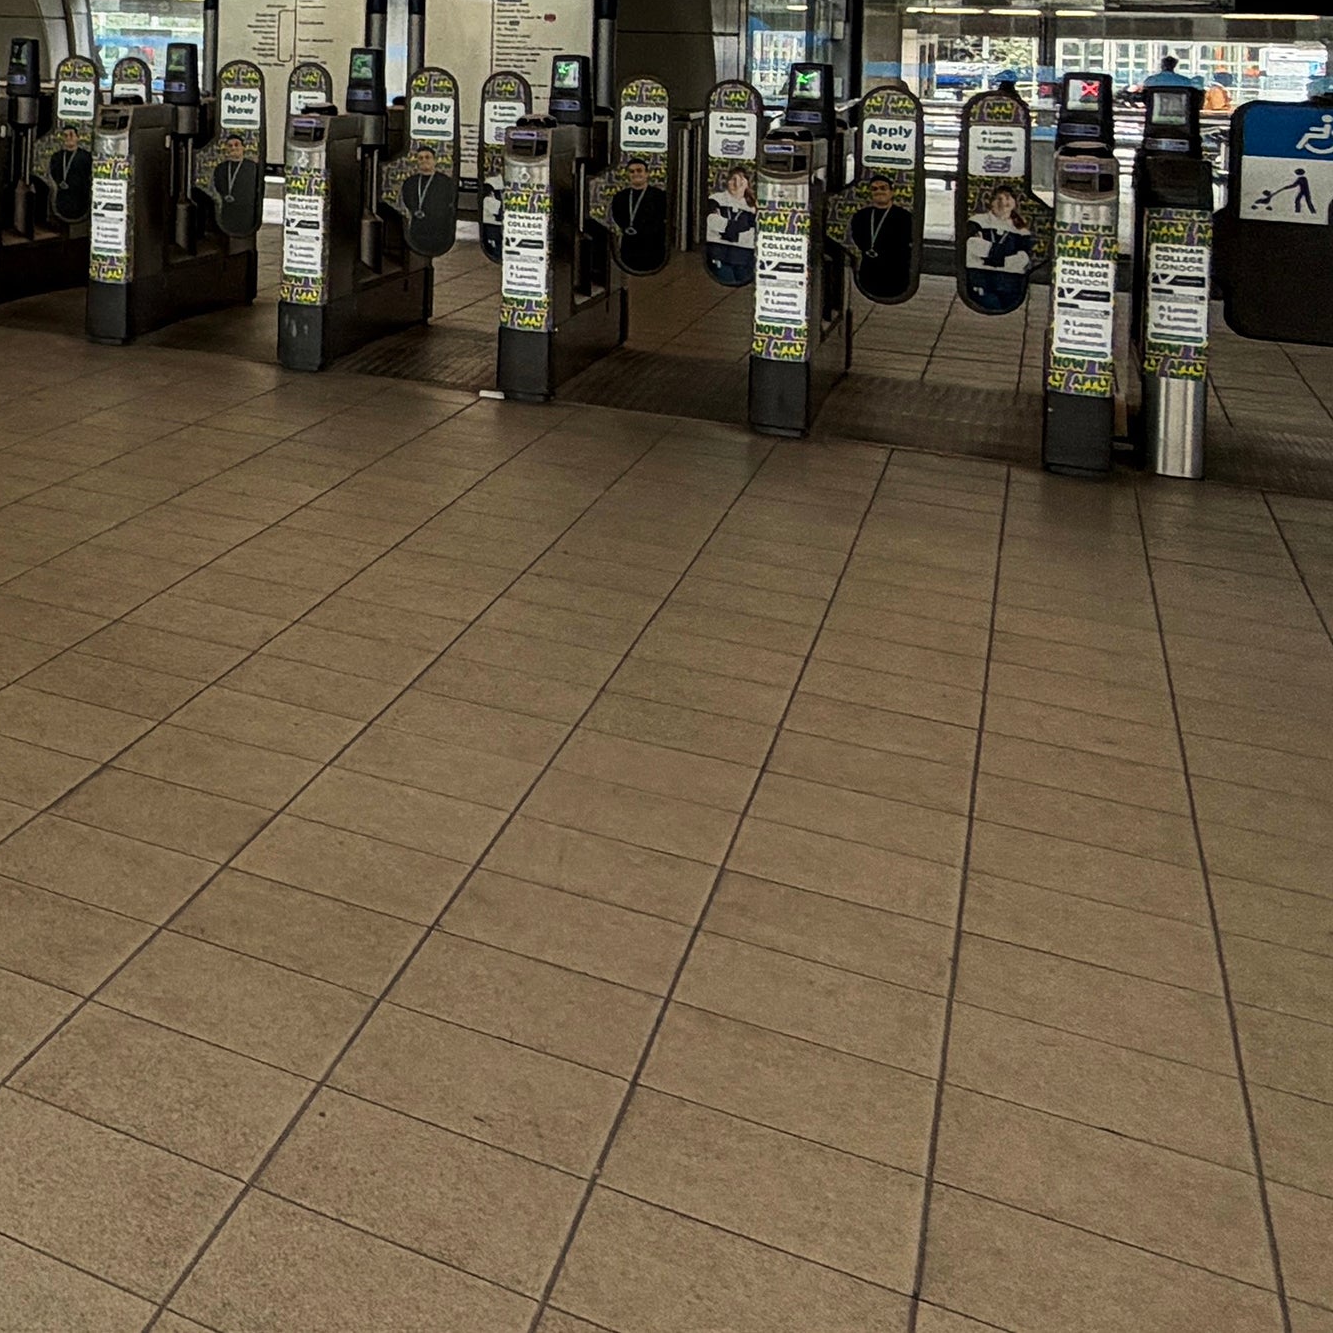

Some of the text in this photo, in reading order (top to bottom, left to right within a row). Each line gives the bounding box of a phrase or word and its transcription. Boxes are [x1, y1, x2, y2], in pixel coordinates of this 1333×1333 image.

[61, 85, 92, 96] Apply
[64, 98, 88, 107] Now
[223, 93, 258, 105] Apply
[227, 105, 254, 115] Now
[413, 101, 451, 115] Apply
[418, 115, 447, 126] Now
[624, 111, 665, 125] Apply
[628, 126, 661, 137] Now
[866, 123, 913, 139] Apply
[871, 139, 906, 152] Now
[762, 243, 803, 252] COLLEGE
[1061, 269, 1108, 279] COLLEGE
